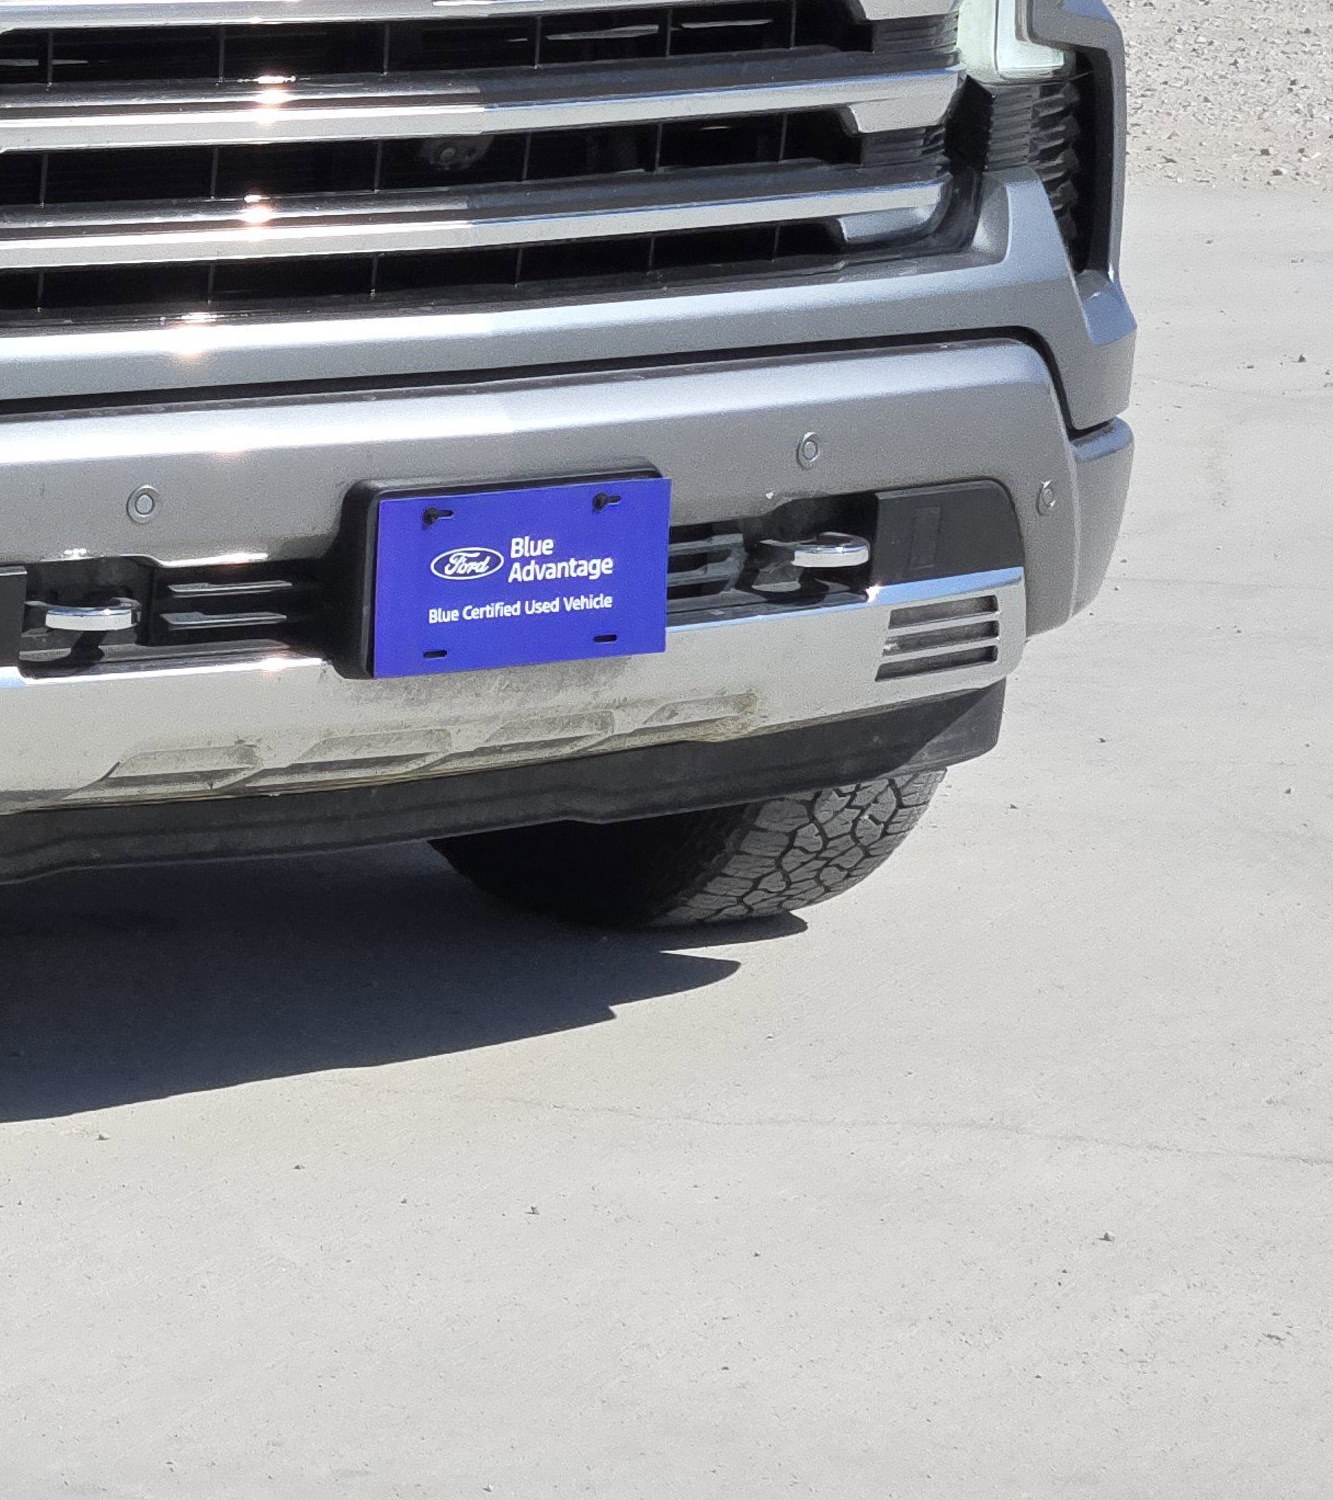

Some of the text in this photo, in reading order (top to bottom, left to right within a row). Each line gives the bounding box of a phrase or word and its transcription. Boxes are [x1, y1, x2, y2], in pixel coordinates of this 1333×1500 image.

[510, 536, 555, 558] Blue
[508, 556, 614, 583] Advantage
[428, 593, 613, 625] Blue Certified Used Vehicle
